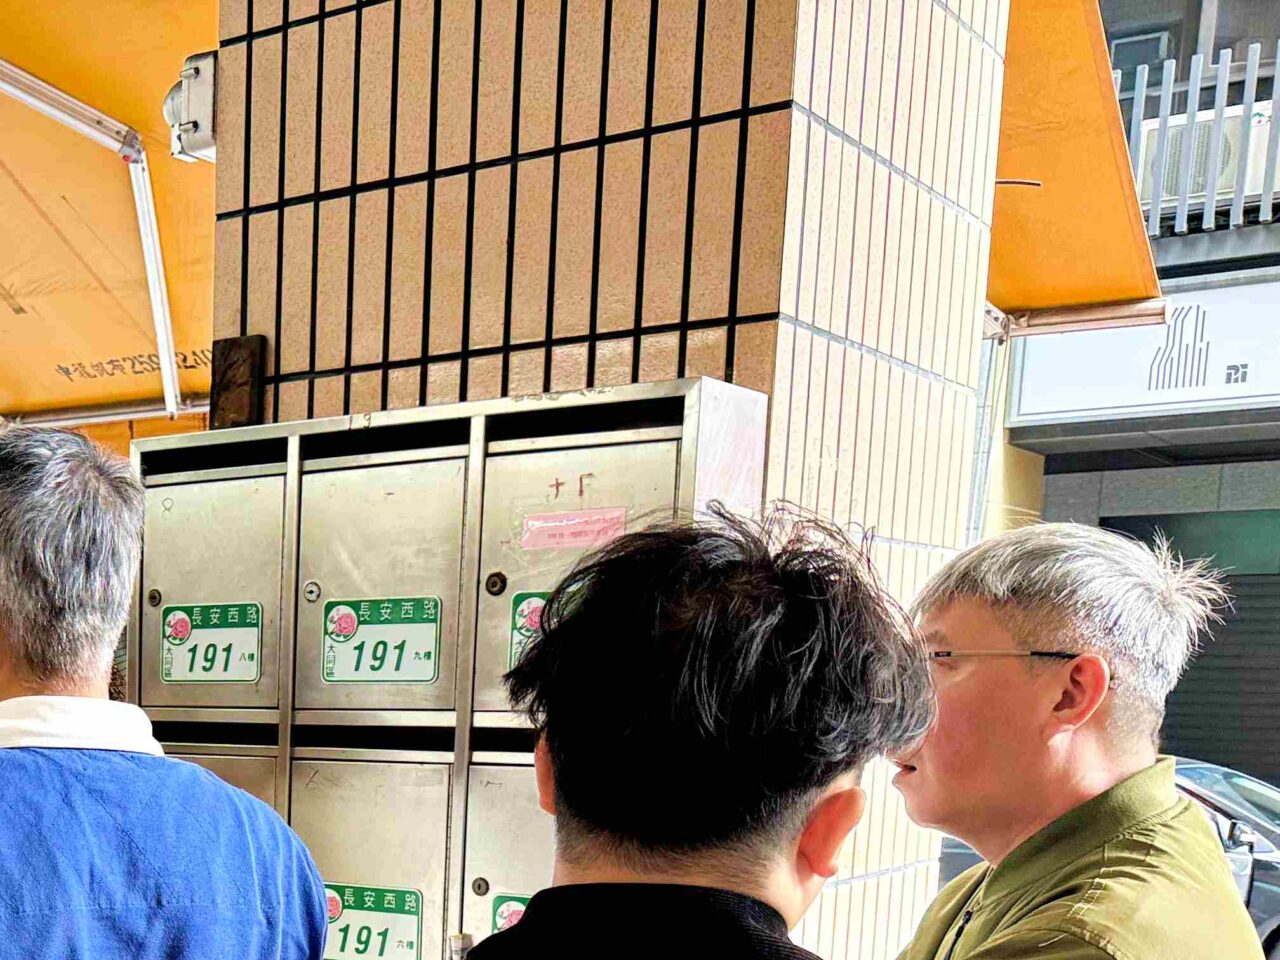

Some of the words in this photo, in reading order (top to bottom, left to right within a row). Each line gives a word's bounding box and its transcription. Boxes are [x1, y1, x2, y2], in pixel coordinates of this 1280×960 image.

[191, 606, 258, 626] 長安西路
[358, 600, 436, 621] 長安西路
[187, 642, 234, 673] 191
[353, 639, 407, 672] 191
[343, 888, 417, 912] 長安西路
[338, 923, 390, 957] 191
